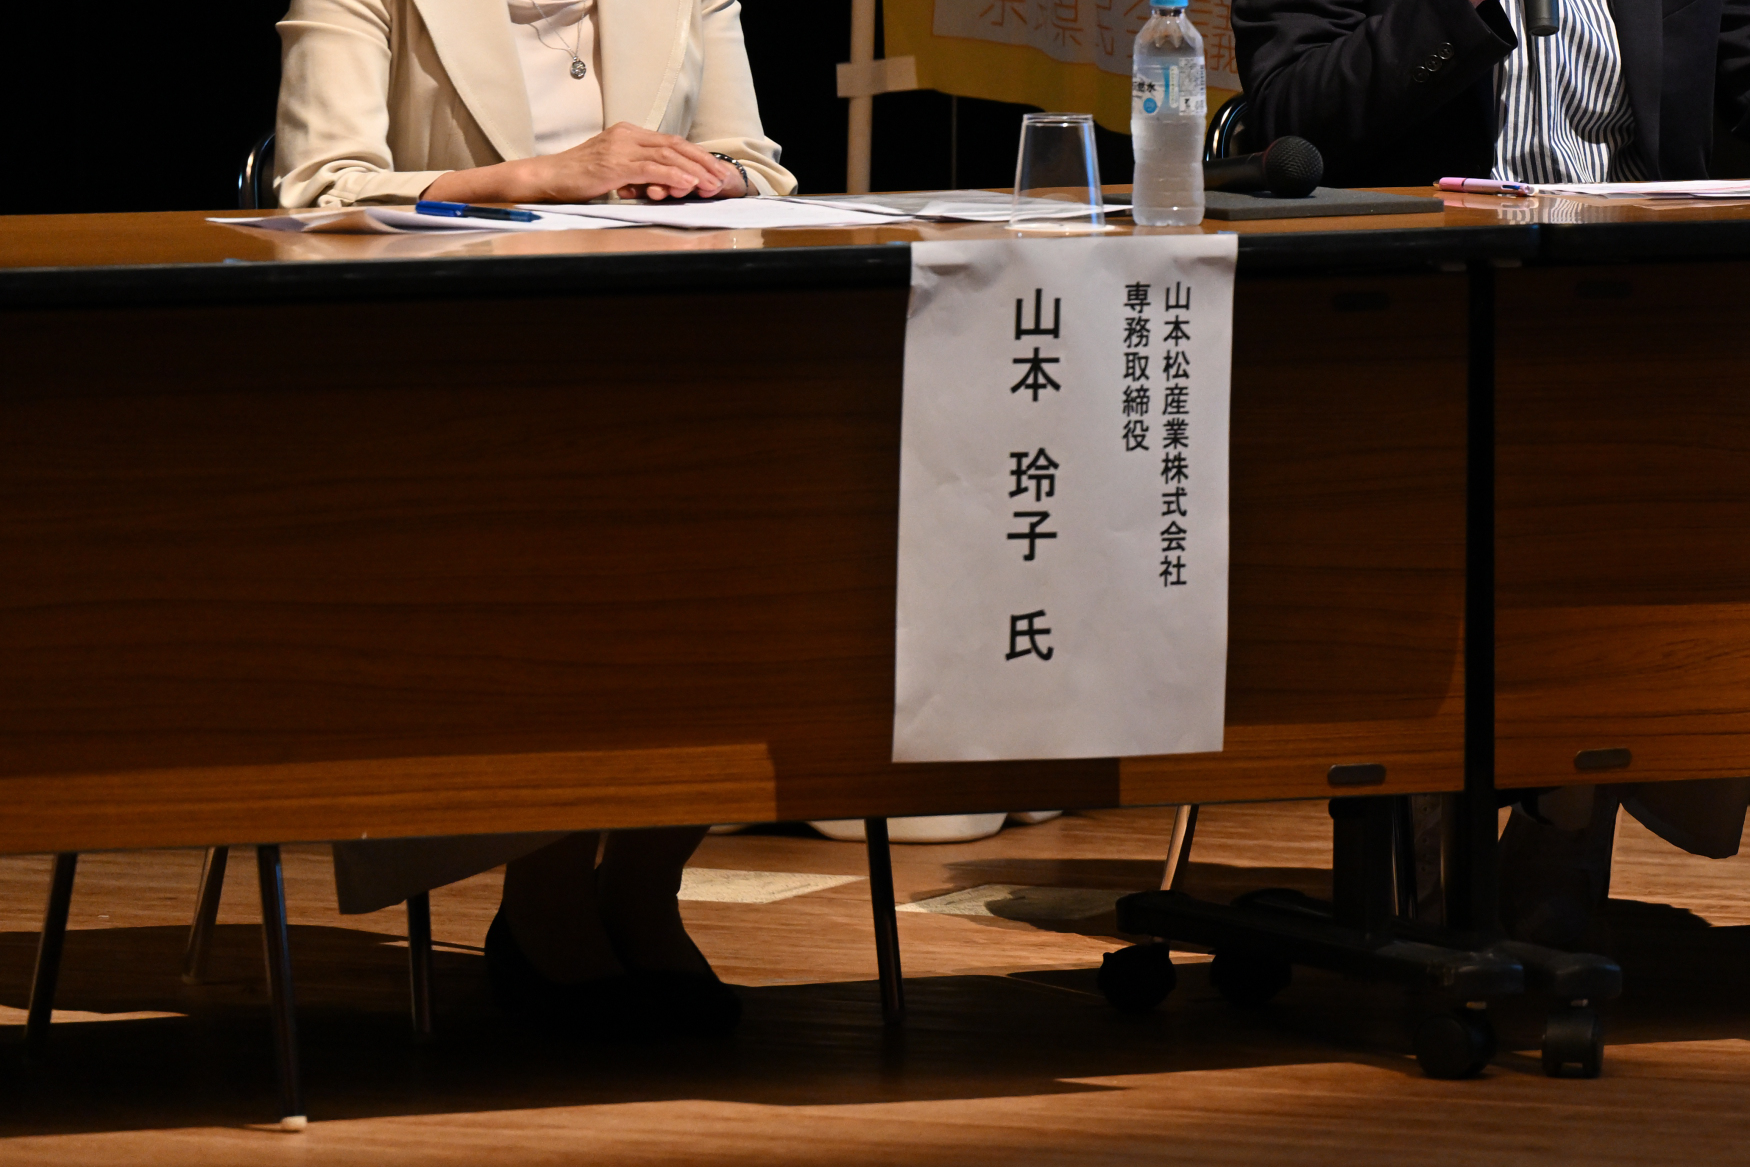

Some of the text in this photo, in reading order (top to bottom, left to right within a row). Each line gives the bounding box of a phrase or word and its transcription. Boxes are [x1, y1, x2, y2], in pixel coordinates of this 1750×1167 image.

[1005, 288, 1062, 662] 山本 玲子 氏
[1122, 281, 1152, 452] 専務取締役
[1159, 280, 1192, 588] 山本松産業株式会社
